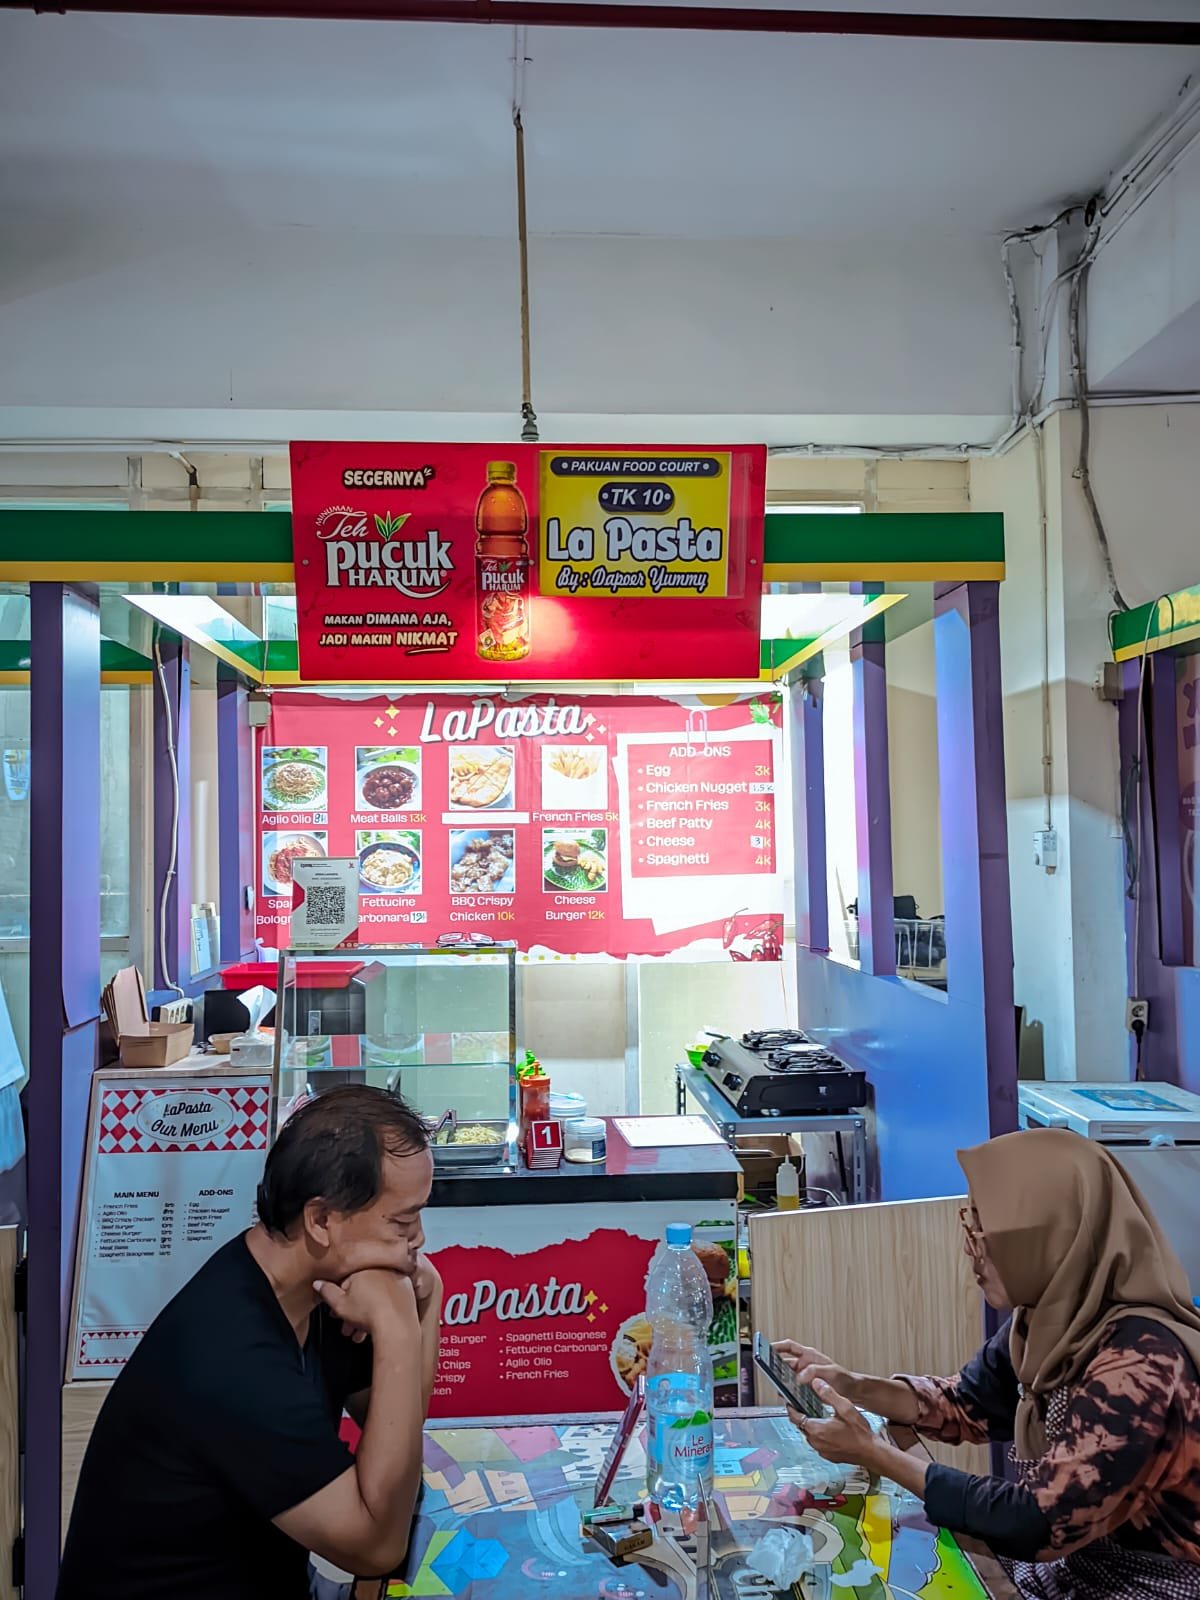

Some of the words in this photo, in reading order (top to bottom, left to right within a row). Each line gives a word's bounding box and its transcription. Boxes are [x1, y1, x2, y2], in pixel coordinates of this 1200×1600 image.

[571, 461, 620, 471] PAKUAN
[623, 461, 656, 472] FOOD
[659, 461, 700, 472] COURT
[344, 470, 424, 486] SEGERNYA
[611, 488, 637, 505] TK
[643, 489, 663, 505] 10
[315, 505, 353, 526] MINUMAN
[317, 511, 369, 539] Teh
[548, 519, 593, 560] La
[605, 518, 722, 561] Pasta
[325, 531, 455, 586] pucuk
[592, 567, 644, 592] Dapoer
[650, 567, 709, 592] Yummy
[324, 615, 363, 625] MAKAN
[366, 613, 418, 625] DIMANA
[423, 613, 452, 626] AJA,
[320, 634, 347, 645] JADI
[351, 634, 392, 645] MAKIN
[396, 631, 458, 646] NIKMAT
[419, 698, 588, 743] LaPasta
[646, 765, 671, 777] Egg
[755, 765, 771, 776] 3k
[646, 782, 698, 793] Chicken
[700, 782, 748, 794] Nugget
[646, 800, 693, 811] French
[695, 799, 729, 811] Fries
[755, 801, 771, 812] 3k
[262, 815, 289, 825] Aglio
[291, 814, 311, 823] Olio
[350, 814, 379, 823] Meat
[381, 813, 407, 823] Balls
[409, 813, 427, 823] 13k
[533, 812, 573, 822] French
[575, 812, 603, 822] Fries
[646, 818, 676, 829] Beef
[679, 818, 712, 830] Patty
[755, 819, 771, 830] 4k
[646, 836, 695, 847] Cheese
[646, 854, 709, 866] Spaghetti
[755, 855, 771, 866] 4k
[362, 898, 415, 907] Fettucine
[451, 897, 476, 907] BBQ
[477, 896, 514, 907] Crispy
[554, 896, 596, 905] Cheese
[450, 912, 495, 921] Chicken
[497, 912, 515, 921] 10k
[545, 911, 587, 921] Burger
[588, 911, 605, 920] 12k
[163, 1102, 213, 1118] LaPasta
[151, 1120, 177, 1137] Our
[181, 1120, 219, 1137] Menu
[541, 1126, 552, 1145] 1
[440, 1276, 588, 1326] aPasta
[450, 1335, 487, 1345] Burger
[506, 1332, 553, 1343] Spaghetti
[555, 1331, 607, 1341] Bolognese
[506, 1345, 552, 1354] Fettucine
[554, 1343, 608, 1353] Carbonara
[443, 1360, 471, 1370] Chips
[505, 1358, 530, 1368] Aglio
[533, 1357, 552, 1366] Olio
[506, 1370, 541, 1380] French
[544, 1369, 569, 1378] Fries
[692, 1435, 704, 1446] Le
